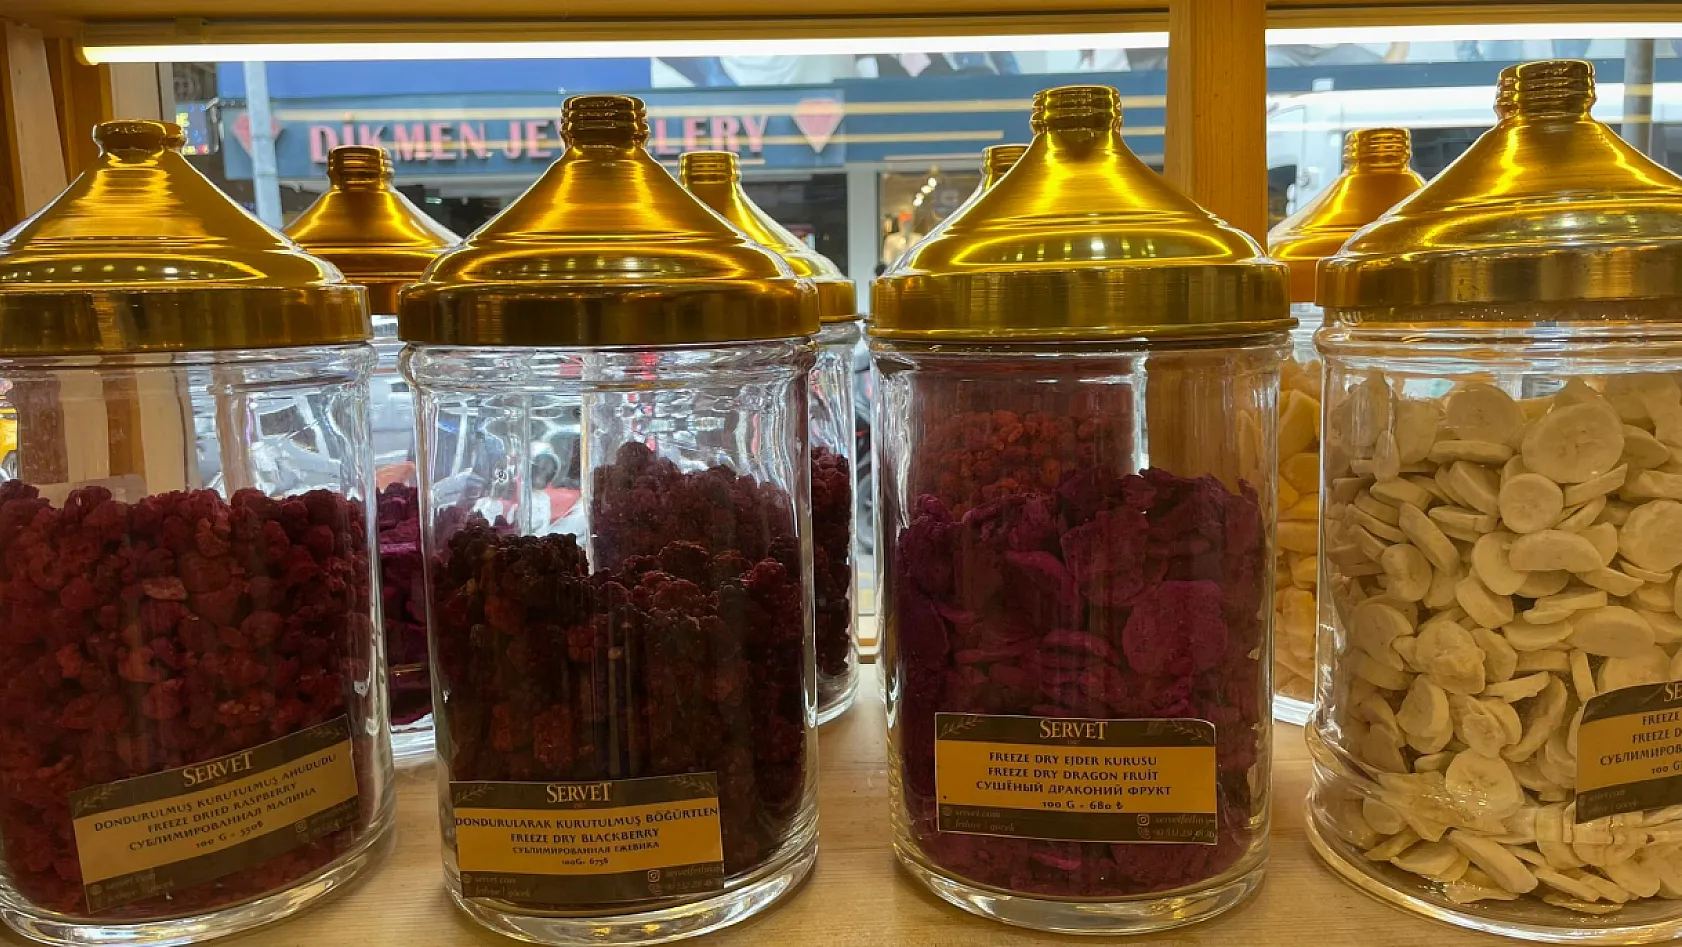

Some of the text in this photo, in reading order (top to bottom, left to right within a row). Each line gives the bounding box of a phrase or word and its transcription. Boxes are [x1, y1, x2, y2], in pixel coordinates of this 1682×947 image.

[309, 112, 769, 163] DİKMEN JELERY
[1642, 711, 1680, 725] FREEZE
[1039, 720, 1109, 740] SERVET
[1632, 729, 1669, 744] FREEZE
[989, 751, 1158, 767] FREEZE DRY EJDER KURUSU
[183, 750, 255, 787] SERVET
[988, 767, 1029, 778] FREEZE
[1033, 768, 1058, 778] DRY
[1063, 770, 1118, 781] DRAGON
[1652, 765, 1669, 774] 100
[94, 753, 337, 832] DONDURULMUŞ KURUTULMUŞ AHUDUDU
[546, 783, 612, 803] SERVET
[976, 780, 1172, 796] СУШЁНЫЙ ДРАКОНИЙ ФРУКТ
[147, 782, 297, 834] FREEZE DRIED RASPBERRY
[266, 787, 317, 812] МАЛИНА
[1042, 801, 1062, 809] 100
[1066, 801, 1075, 810] G
[1089, 800, 1111, 810] 680
[455, 807, 718, 829] DONDURULARAK KURUTULMUŞ BÖĞÜRTLEN
[510, 827, 660, 843] FREEZE DRY BLACKBERRY
